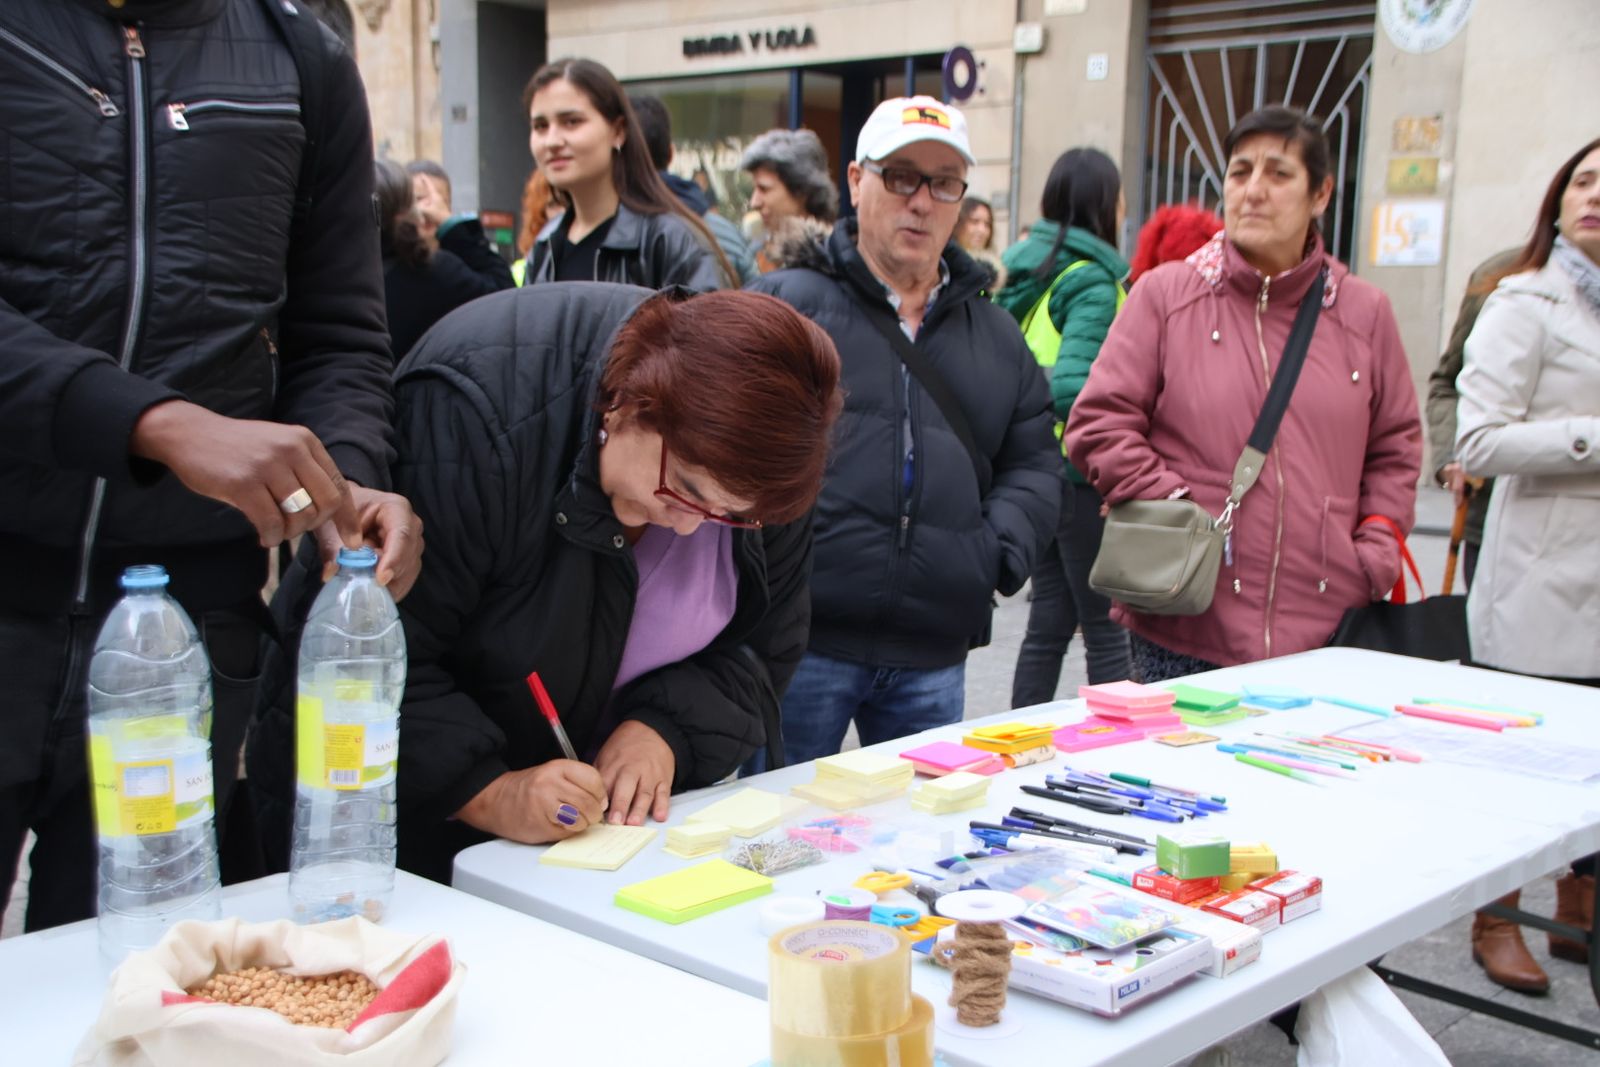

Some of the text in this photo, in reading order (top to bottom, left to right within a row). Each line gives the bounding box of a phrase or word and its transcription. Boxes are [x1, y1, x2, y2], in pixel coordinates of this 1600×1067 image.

[748, 30, 761, 52] Y
[765, 24, 816, 51] LOLA
[817, 927, 869, 937] Q-CONNECT
